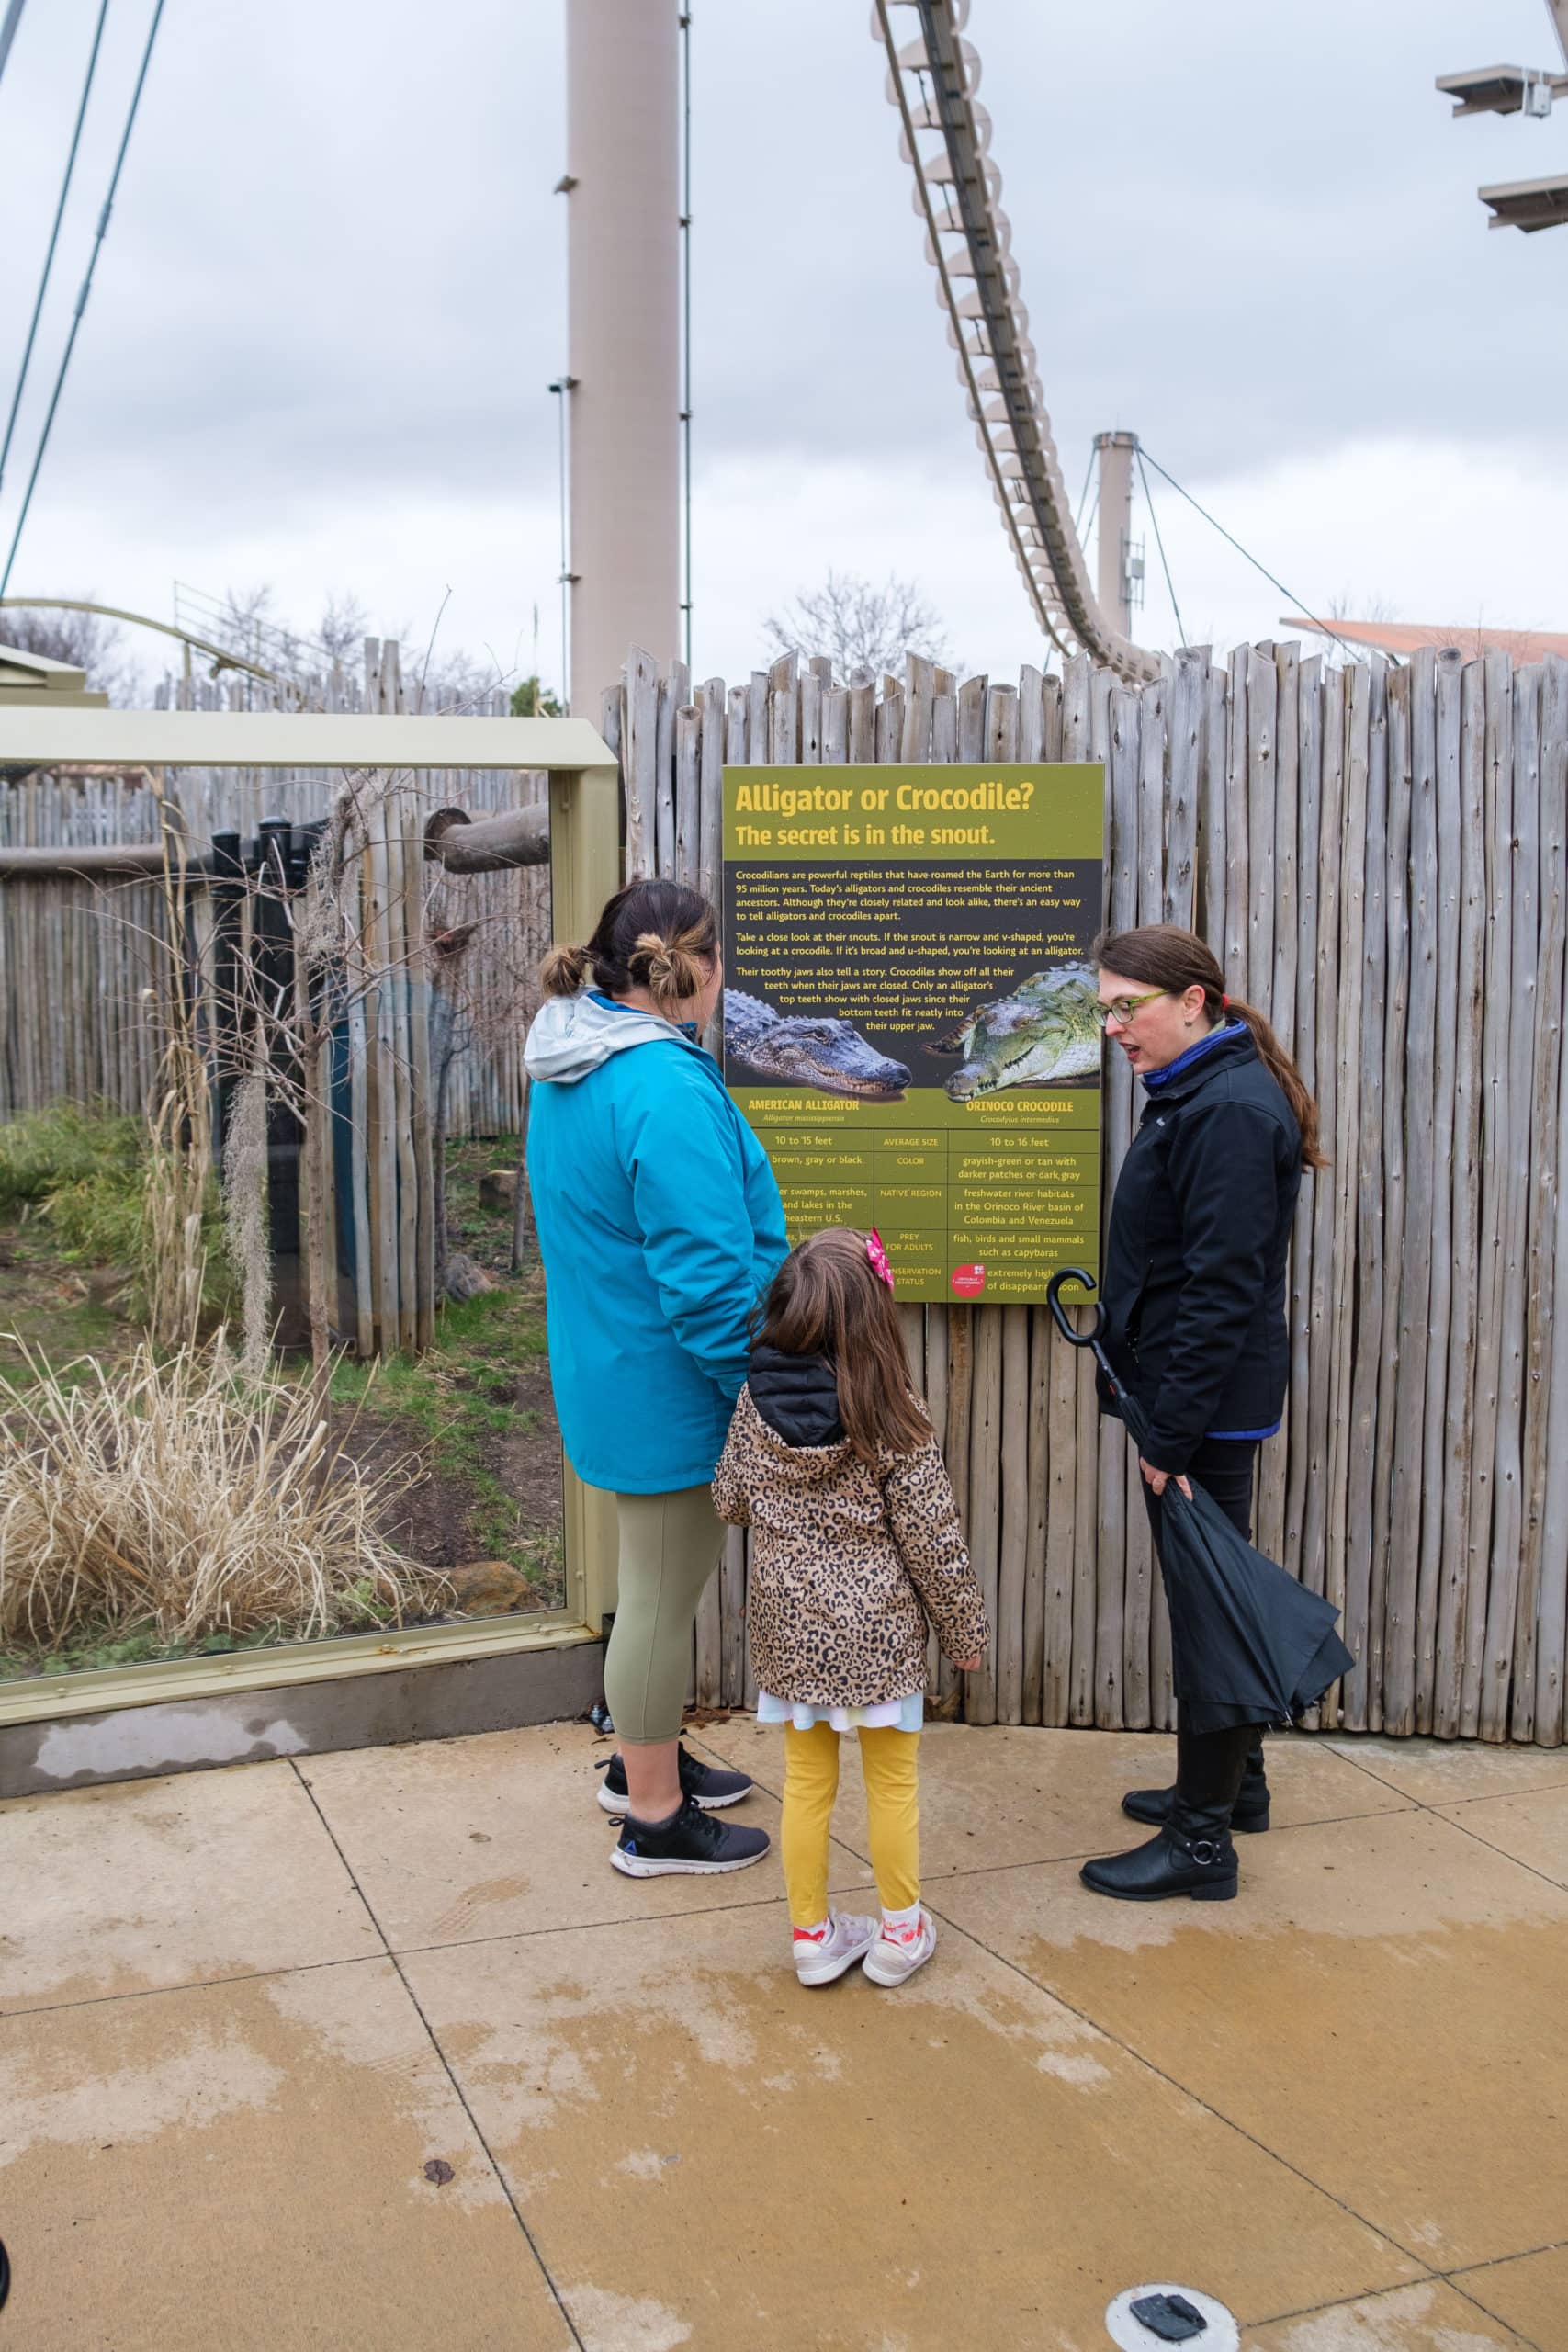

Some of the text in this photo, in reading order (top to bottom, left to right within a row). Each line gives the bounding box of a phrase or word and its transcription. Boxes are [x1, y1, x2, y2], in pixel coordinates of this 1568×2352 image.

[735, 782, 1034, 818] Alligator or Crocodile?
[735, 823, 996, 845] The secret is in the snout.
[735, 871, 790, 880] Crocodilians
[808, 870, 847, 882] powerful
[850, 870, 883, 881] reptiles
[885, 870, 905, 879] that
[908, 870, 930, 879] have
[931, 869, 964, 879] roamed
[966, 870, 982, 879] the
[985, 869, 1010, 878] Earth
[1012, 869, 1025, 878] for
[1053, 869, 1075, 878] than
[736, 884, 1053, 895] 95 million years. Today's alligators and crocodiles resemble their ancient
[783, 898, 823, 909] Although
[826, 898, 857, 909] they're
[860, 898, 890, 909] closely
[893, 898, 924, 907] related
[926, 897, 942, 906] and
[945, 897, 965, 906] look
[967, 897, 991, 907] alike,
[994, 897, 1023, 906] there's
[1040, 899, 1060, 908] easy
[1062, 899, 1081, 908] way
[749, 911, 763, 921] tell
[766, 911, 807, 922] alligators
[808, 911, 825, 921] and
[828, 911, 872, 921] crocodiles
[874, 912, 901, 922] apart.
[735, 933, 756, 942] Take
[766, 933, 788, 942] close
[791, 933, 810, 941] look
[825, 933, 847, 941] their
[884, 933, 891, 941] If
[893, 933, 908, 941] the
[939, 933, 946, 941] is
[983, 933, 999, 941] and
[1001, 933, 1044, 944] v-shaped,
[1047, 933, 1075, 943] you're
[736, 946, 769, 957] looking
[771, 947, 781, 956] at
[791, 946, 833, 956] crocodile.
[836, 946, 843, 955] If
[845, 946, 858, 955] it's
[861, 946, 886, 956] broad
[889, 946, 906, 955] and
[908, 945, 951, 956] u-shaped,
[953, 946, 981, 956] you're
[983, 946, 1016, 957] looking
[1044, 945, 1084, 957] alligator.
[736, 967, 759, 976] Their
[761, 967, 792, 978] toothy
[794, 969, 814, 978] jaws
[816, 967, 834, 976] also
[836, 967, 851, 976] tell
[862, 968, 887, 978] story.
[889, 967, 936, 976] Crocodiles
[938, 967, 961, 976] show
[963, 967, 976, 976] off
[979, 967, 990, 976] all
[993, 967, 1014, 976] their
[764, 980, 788, 989] teeth
[791, 981, 815, 989] when
[818, 980, 839, 989] their
[840, 981, 861, 991] jaws
[879, 981, 909, 989] closed.
[911, 980, 934, 991] Only
[950, 980, 993, 992] alligator's
[779, 994, 970, 1005] top teeth show with closed jaws since their
[839, 1008, 964, 1019] bottom teeth fit neatly into
[866, 1022, 935, 1033] their upper jaw.
[749, 1100, 860, 1110] AMERICAN ALLIGATOR
[966, 1101, 1073, 1112] ORINOCO CROCODILE
[775, 1136, 786, 1145] 10
[801, 1136, 812, 1145] 15
[814, 1136, 832, 1145] feet
[921, 1138, 939, 1147] SIZE
[990, 1137, 1001, 1147] 10
[1017, 1137, 1028, 1147] 16
[1031, 1137, 1049, 1147] feet
[772, 1154, 803, 1165] brown,
[805, 1156, 824, 1166] gray
[839, 1155, 863, 1164] black
[963, 1156, 1022, 1168] grayish-green
[1037, 1158, 1053, 1166] tan
[1055, 1157, 1077, 1166] with
[964, 1189, 1012, 1198] freshwater
[1037, 1189, 1075, 1198] habitats
[801, 1200, 823, 1209] lakes
[837, 1201, 852, 1209] the
[964, 1215, 1073, 1225] Colombia and Venezuela
[953, 1234, 1084, 1244] fish, birds and small mammals
